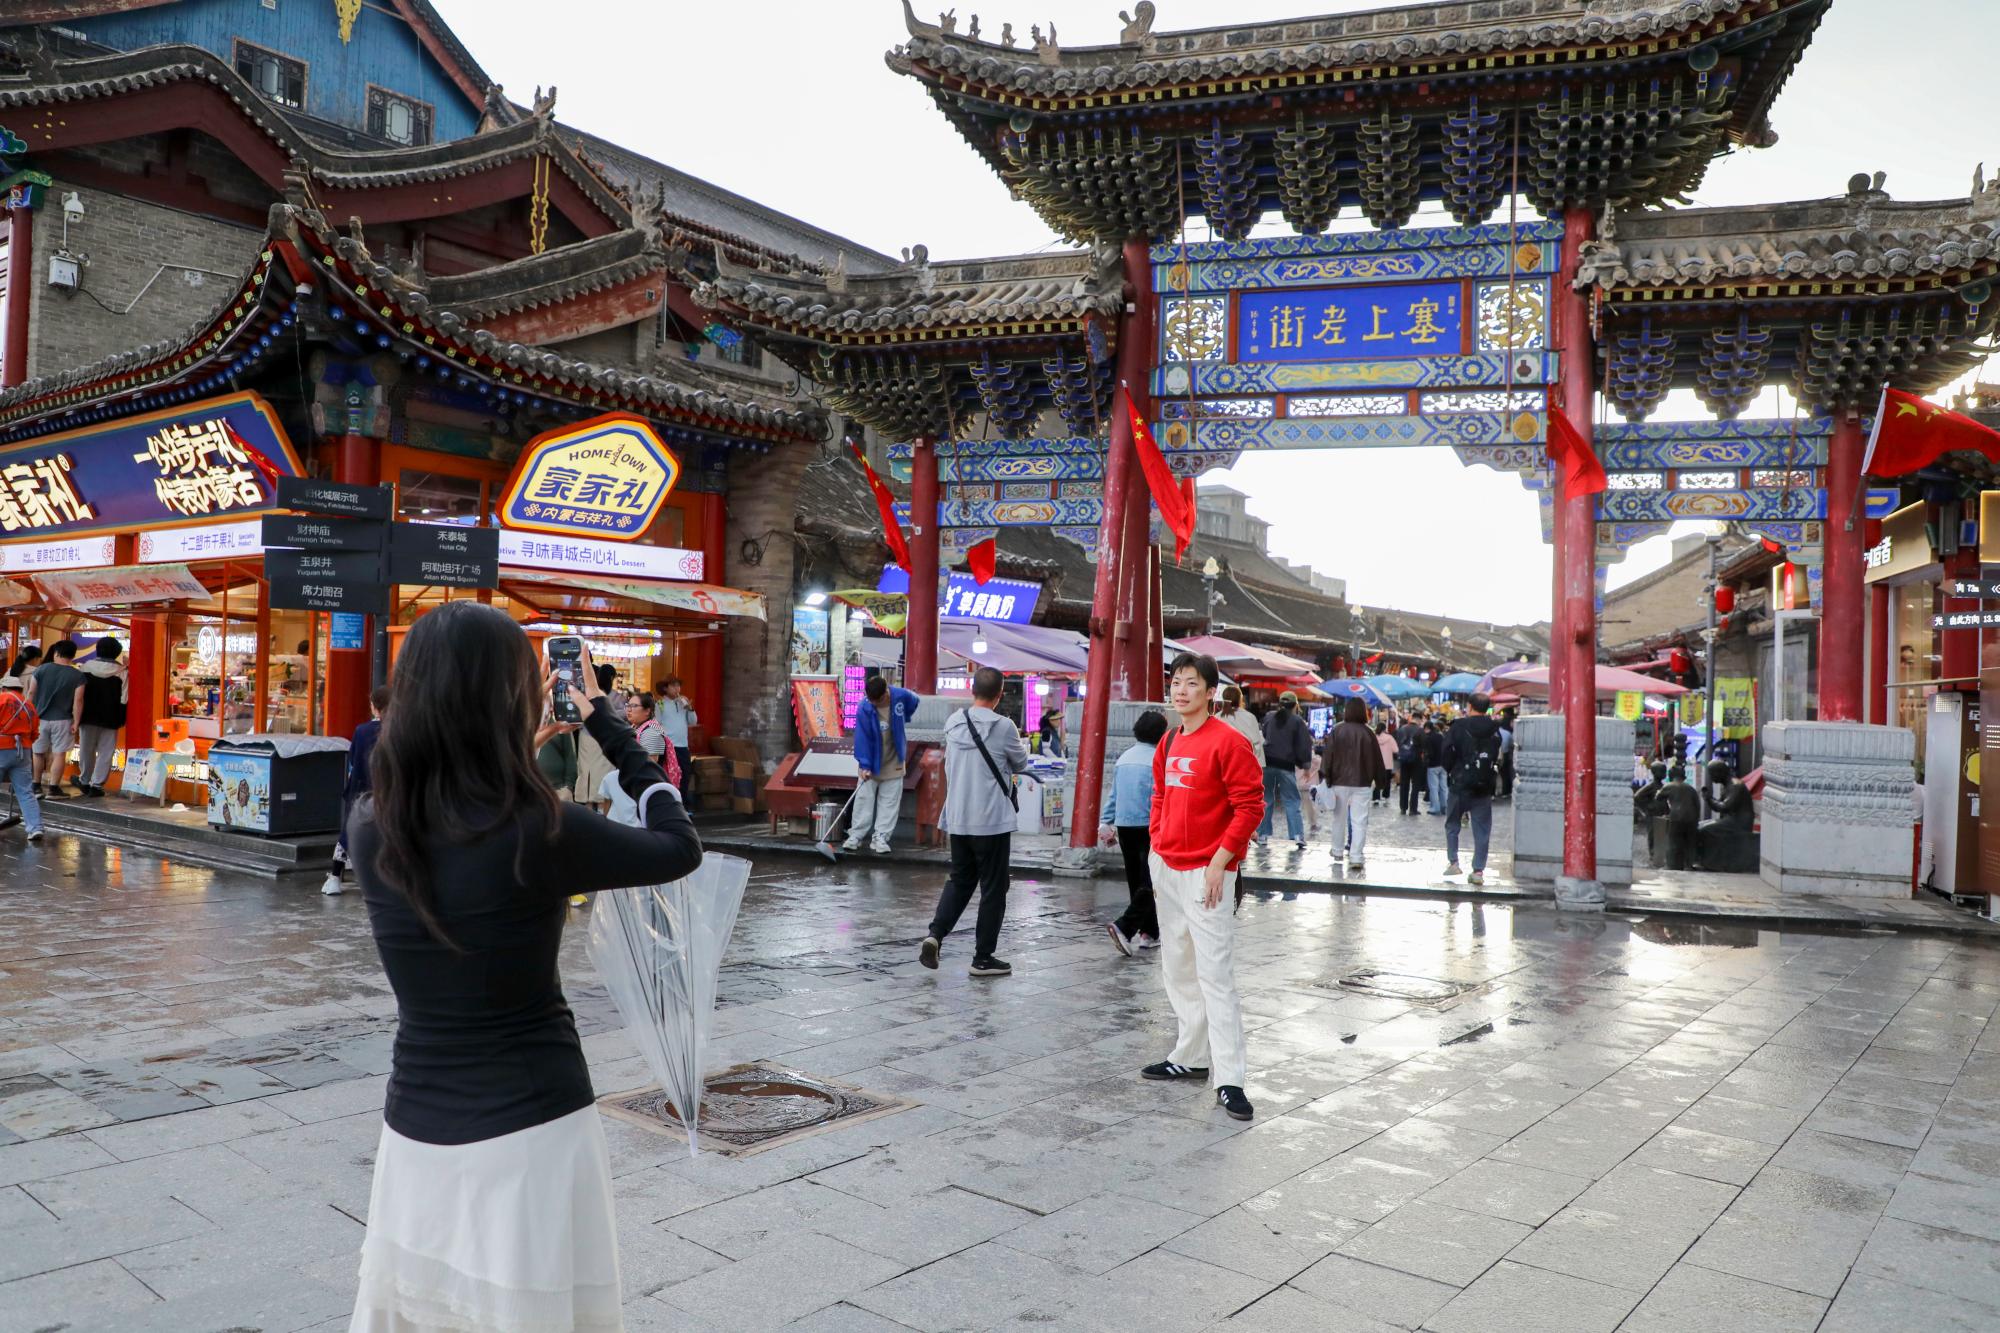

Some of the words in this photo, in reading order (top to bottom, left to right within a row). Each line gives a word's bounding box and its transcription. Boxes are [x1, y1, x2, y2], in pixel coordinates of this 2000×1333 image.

[1269, 297, 1446, 348] 塞上老街
[133, 418, 248, 475] 一份特产礼
[154, 464, 262, 516] 代表内蒙古
[534, 466, 648, 510] 蒙家礼
[541, 507, 614, 527] 内蒙吉祥礼
[297, 524, 330, 537] 财神庙
[437, 530, 468, 543] 禾泰城
[180, 531, 236, 552] 十二盟市干果礼
[300, 556, 333, 568] 玉泉井
[520, 540, 620, 567] 寻味青城点心礼
[621, 559, 646, 568] Dessert
[297, 569, 320, 577] Yuquan
[421, 561, 481, 576] 阿勒坦汗广场
[301, 584, 343, 598] 席力图召
[957, 590, 1016, 620] 草原酸奶
